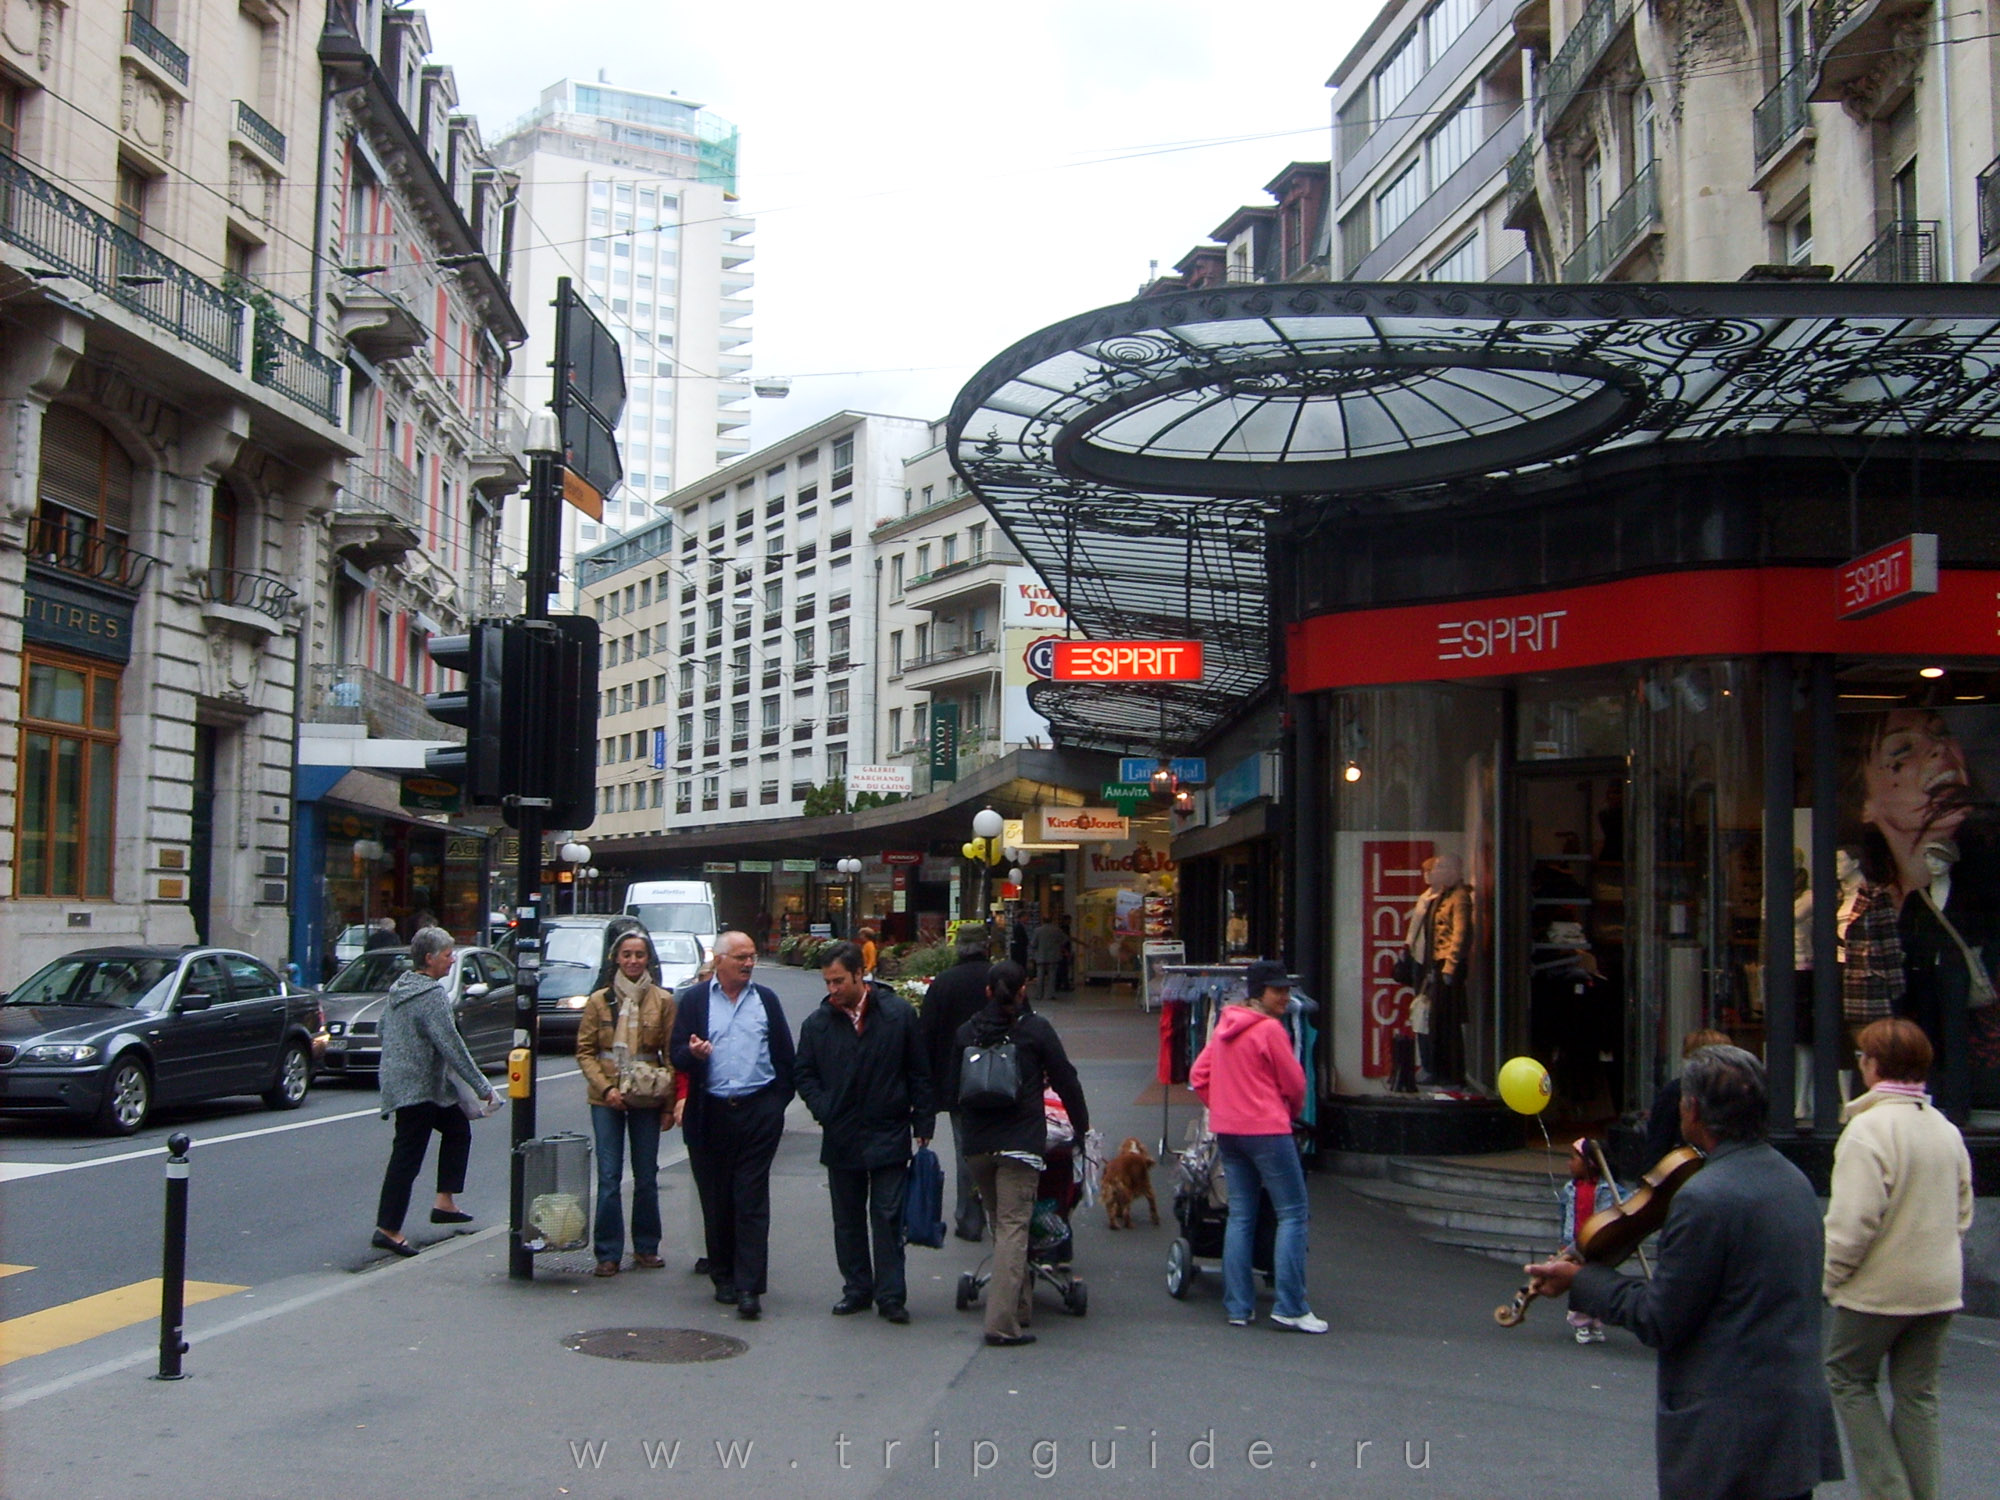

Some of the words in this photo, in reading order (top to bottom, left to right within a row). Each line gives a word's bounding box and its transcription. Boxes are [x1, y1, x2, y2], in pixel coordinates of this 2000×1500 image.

[1845, 551, 1904, 607] ESPRIT
[24, 596, 119, 638] TITRES
[1024, 601, 1067, 617] Jou
[1438, 610, 1568, 658] ESPRIT
[1071, 647, 1184, 675] ESPRIT
[935, 716, 946, 766] PAYOT
